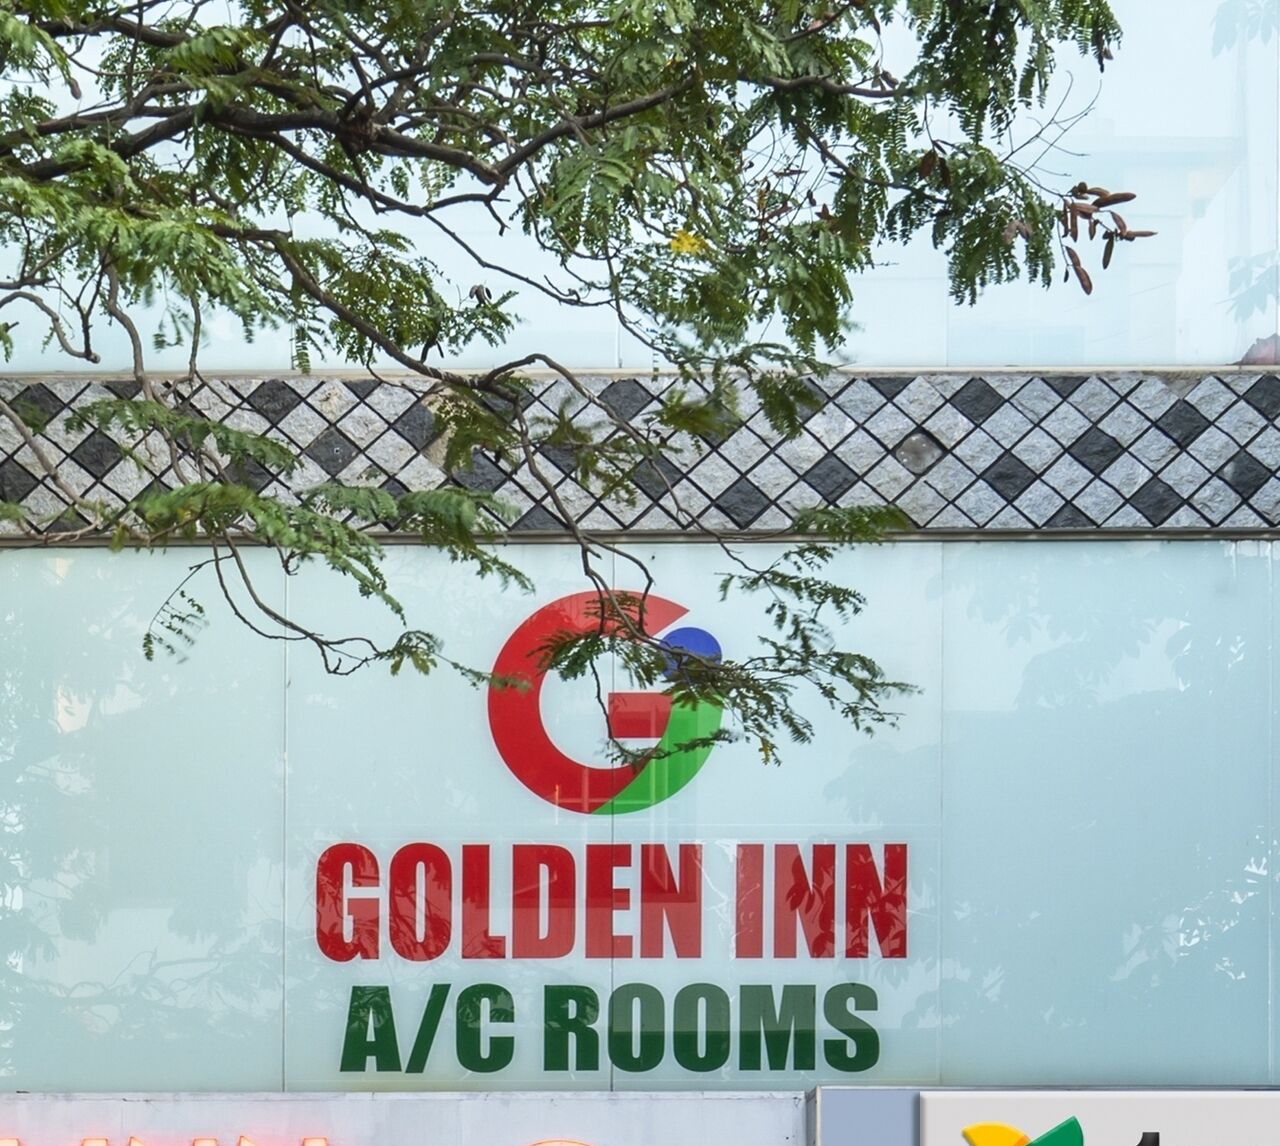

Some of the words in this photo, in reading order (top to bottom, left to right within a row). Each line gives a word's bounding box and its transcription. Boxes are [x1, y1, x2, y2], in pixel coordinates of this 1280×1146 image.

[316, 842, 703, 962] GOLDEN
[734, 843, 908, 959] INN
[339, 982, 516, 1074] A/C
[543, 982, 880, 1073] ROOMS
